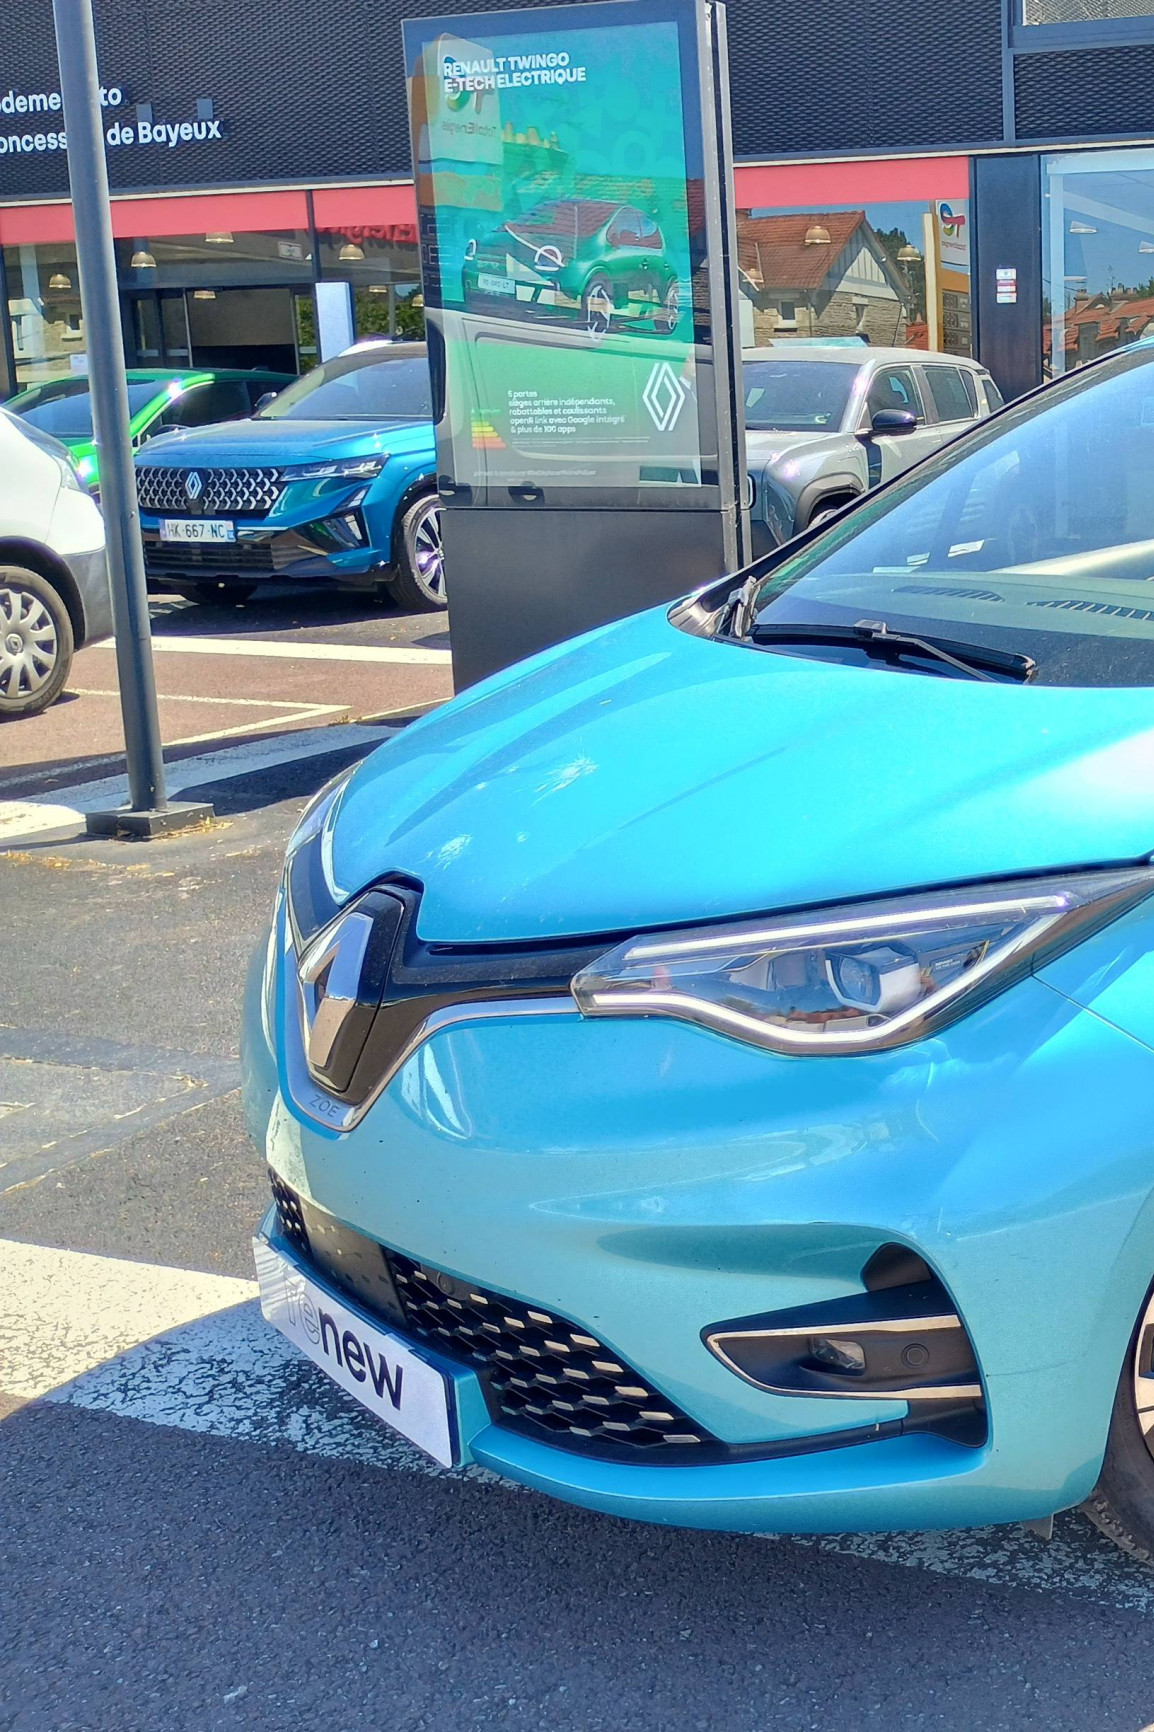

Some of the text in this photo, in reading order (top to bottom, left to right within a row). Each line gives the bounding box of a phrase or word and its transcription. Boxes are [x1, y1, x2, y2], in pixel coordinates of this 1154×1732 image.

[443, 52, 570, 77] RENAULT TWINGO
[444, 67, 586, 93] E-TECH ELECTRIQUE
[0, 120, 223, 153] oncess de Bayeux
[513, 389, 538, 400] portes
[509, 407, 553, 416] rabattables
[562, 406, 607, 415] coulissants
[534, 416, 548, 424] link
[568, 415, 595, 426] Google
[517, 426, 533, 434] plus
[557, 426, 576, 435] apps
[310, 1093, 340, 1119] ZOE
[285, 1274, 403, 1411] renew
